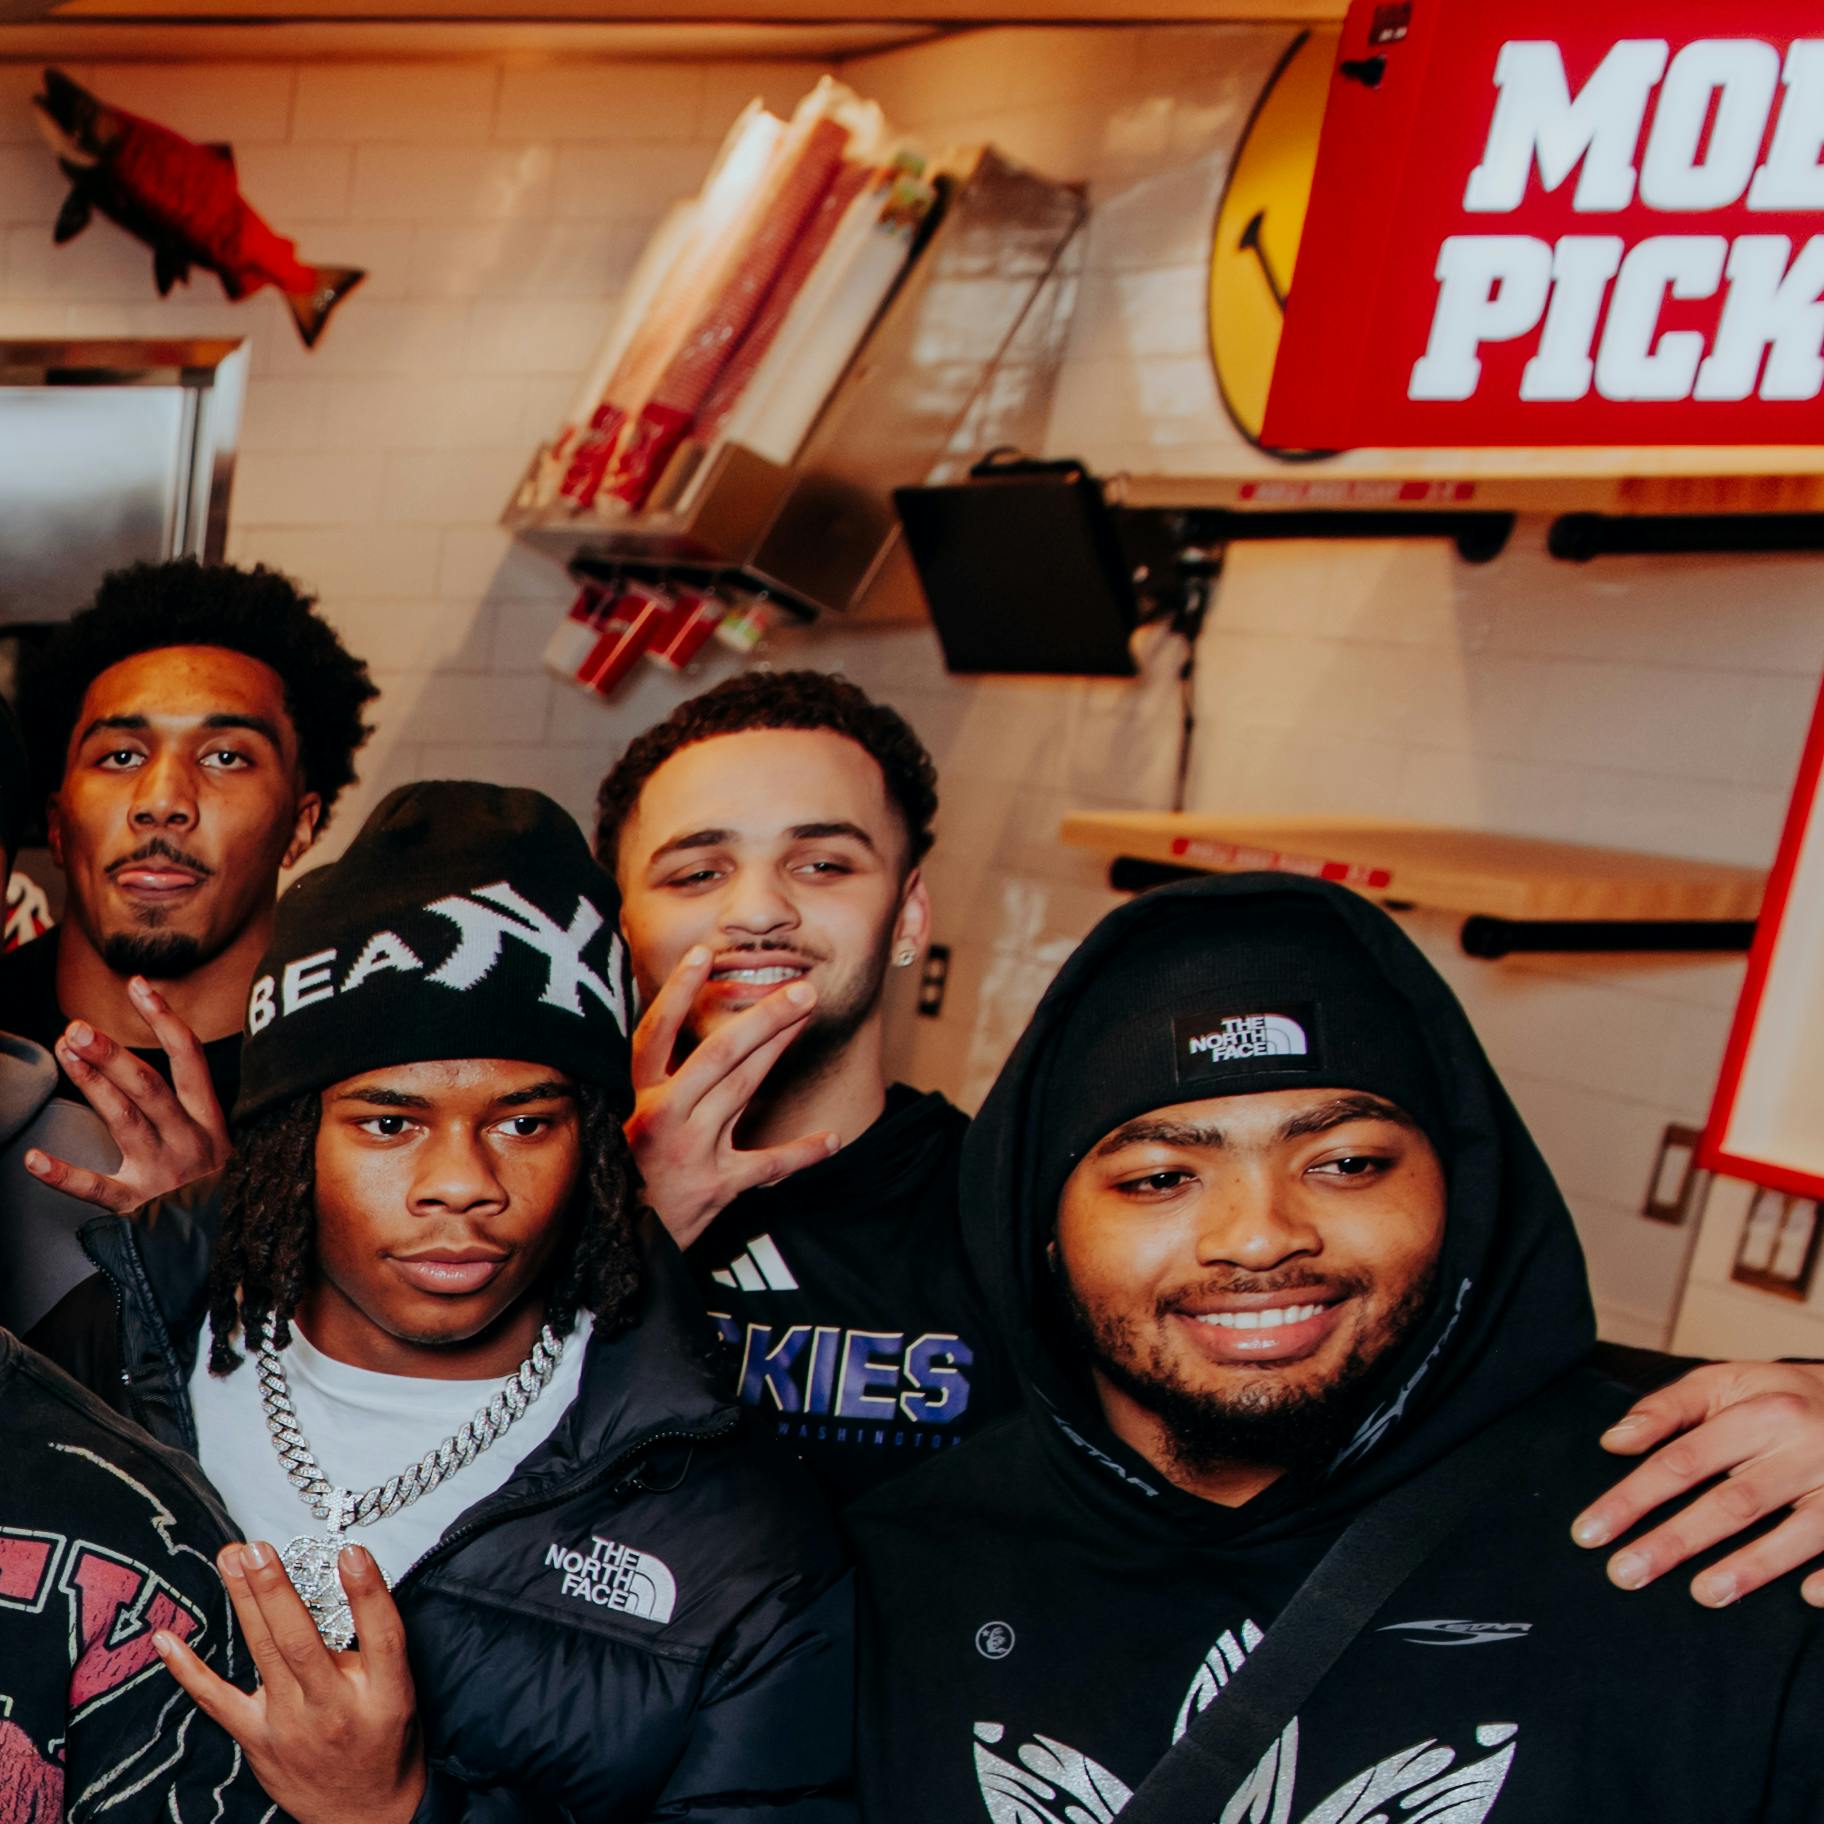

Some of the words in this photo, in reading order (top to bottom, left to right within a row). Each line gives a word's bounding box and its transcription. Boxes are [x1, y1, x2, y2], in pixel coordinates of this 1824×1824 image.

[1221, 1015, 1266, 1034] THE
[1189, 1028, 1266, 1055] NORTH
[1212, 1041, 1268, 1063] FACE
[545, 1543, 635, 1592] NORTH
[592, 1535, 640, 1570] THE
[561, 1572, 629, 1612] FACE
